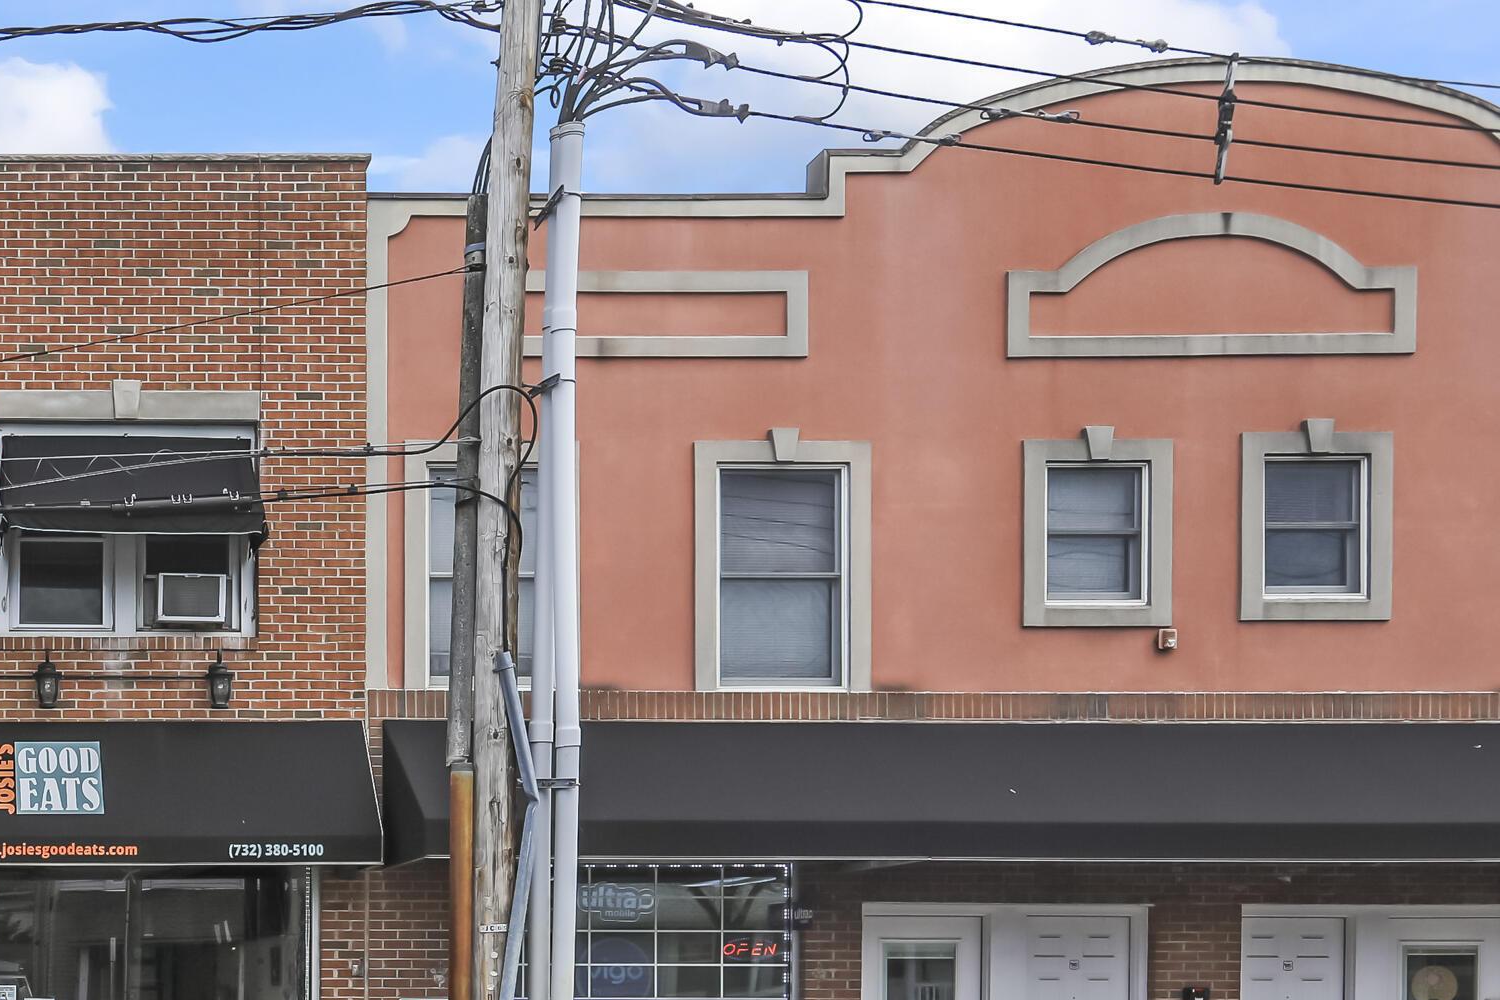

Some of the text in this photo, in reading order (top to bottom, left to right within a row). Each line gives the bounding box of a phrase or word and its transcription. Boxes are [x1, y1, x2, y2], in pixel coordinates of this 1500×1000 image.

[17, 747, 100, 774] GOOD
[19, 777, 101, 812] EATS
[228, 843, 324, 859] (732) 380-5100
